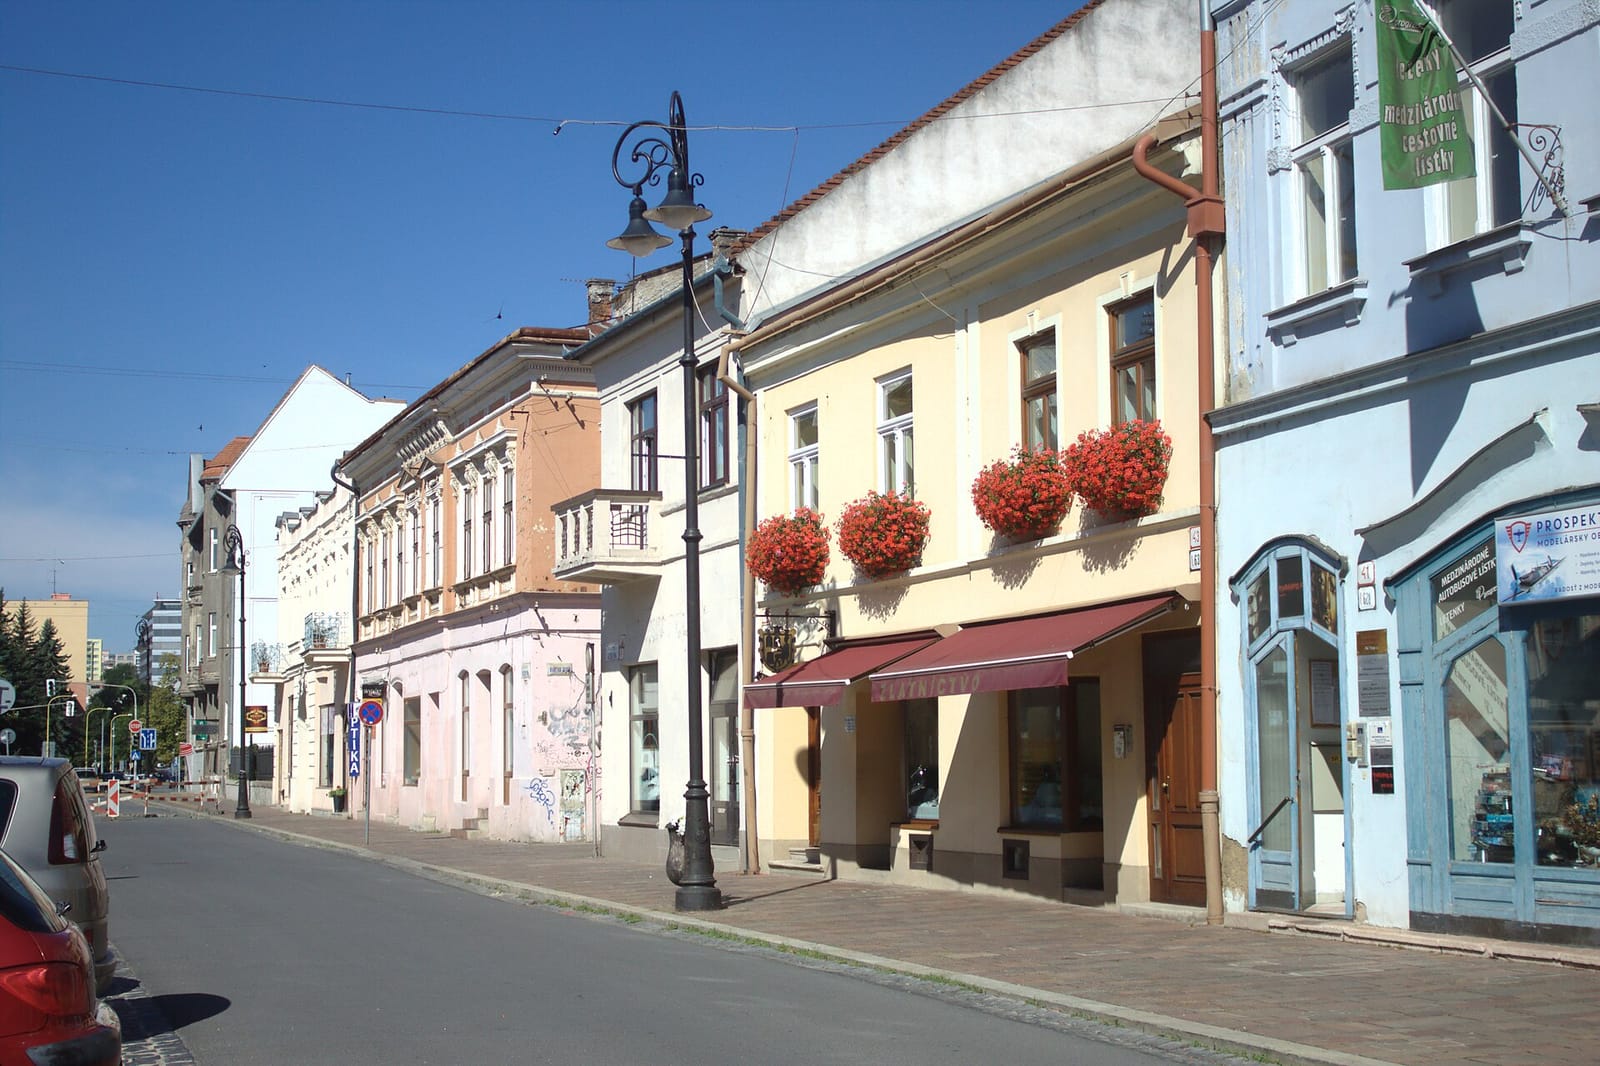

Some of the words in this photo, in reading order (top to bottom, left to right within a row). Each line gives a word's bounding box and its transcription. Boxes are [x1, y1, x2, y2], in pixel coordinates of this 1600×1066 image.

[1402, 116, 1458, 152] cestovné
[1415, 148, 1454, 177] lístky
[1537, 534, 1588, 547] MODELÁRSKY
[1361, 565, 1370, 580] 41
[1438, 569, 1479, 603] AUTOBUSOVÉ
[1478, 556, 1496, 577] LÍSTK
[1441, 546, 1490, 588] MEDZINÁRODNÉ
[1439, 602, 1465, 627] LETENKY
[350, 716, 360, 774] PTIKA
